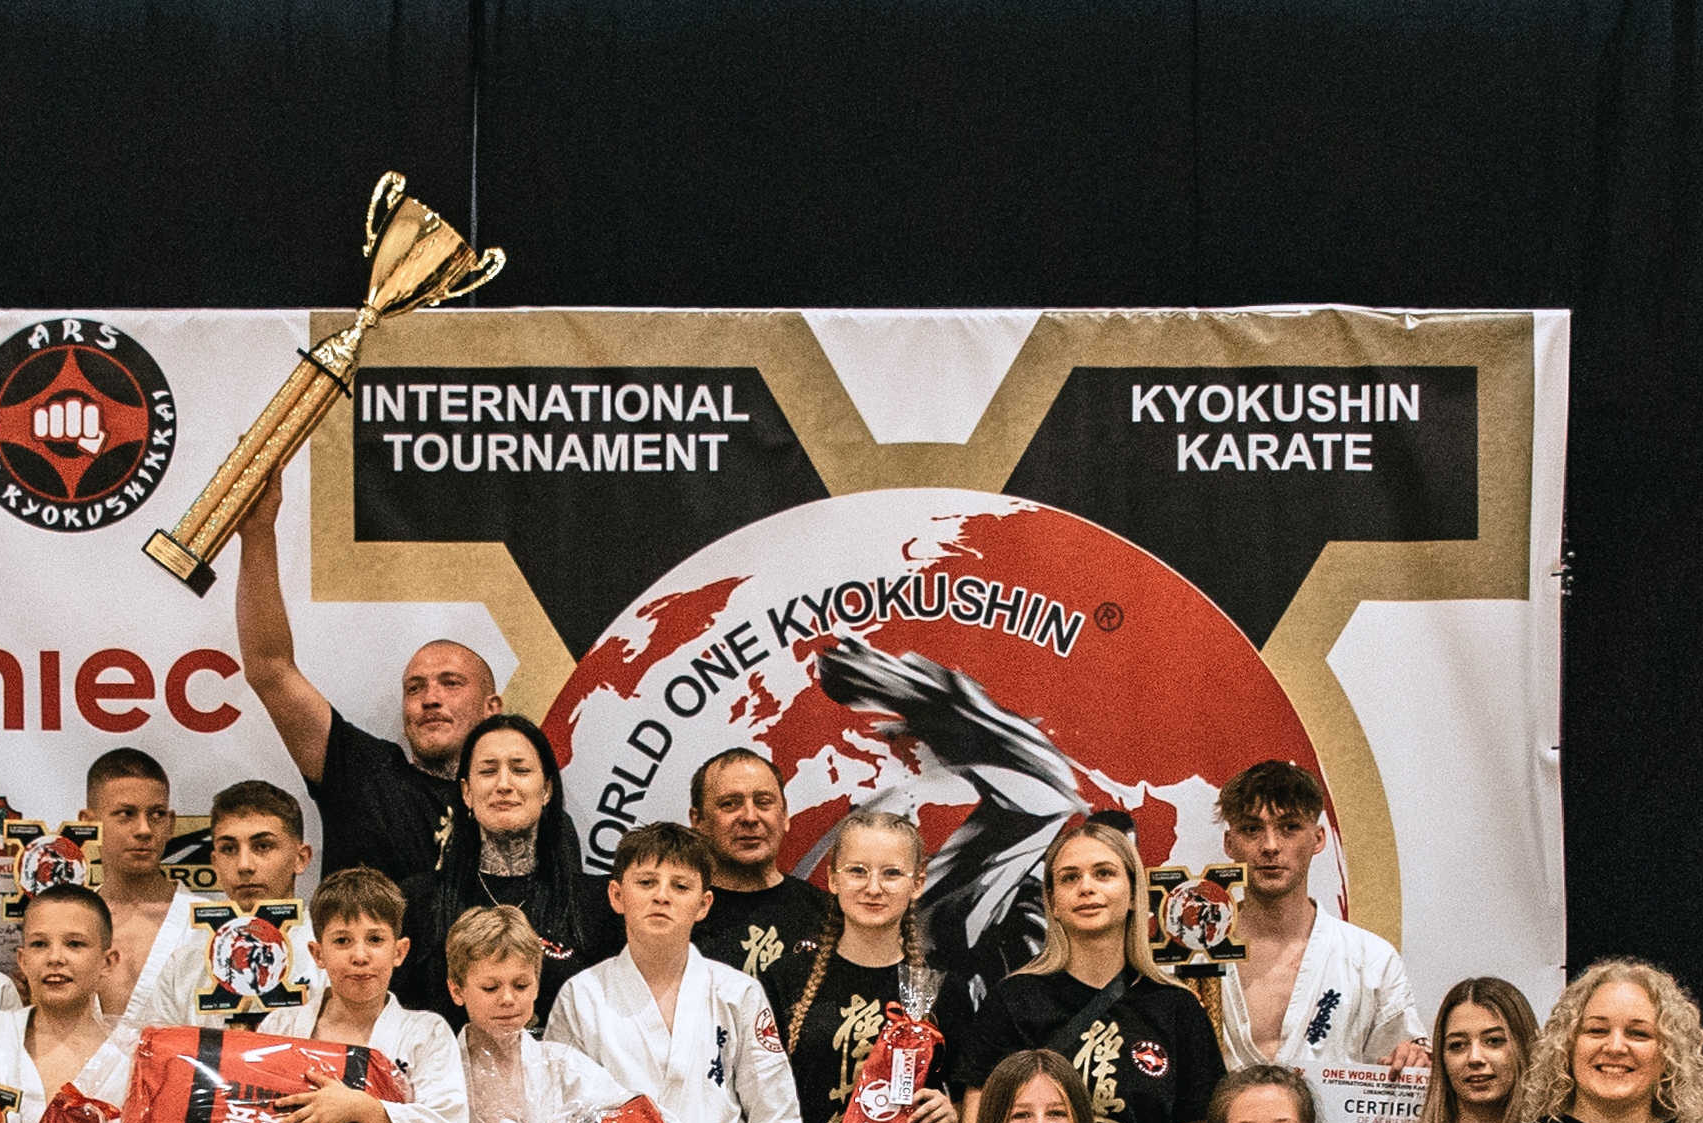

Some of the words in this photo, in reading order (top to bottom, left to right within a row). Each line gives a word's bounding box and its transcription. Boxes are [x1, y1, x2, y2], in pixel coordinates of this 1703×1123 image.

[28, 319, 119, 349] ARS
[361, 383, 750, 424] INTERNATIONAL
[1131, 382, 1422, 424] KYOKUSHIN
[383, 432, 729, 473] TOURNAMENT
[1176, 432, 1373, 472] KARATE
[585, 719, 673, 875] ORLD
[664, 621, 770, 718] ONE
[767, 571, 1085, 659] KYOKUSHIN
[1322, 1069, 1345, 1079] ONE
[1348, 1071, 1386, 1081] WORLD
